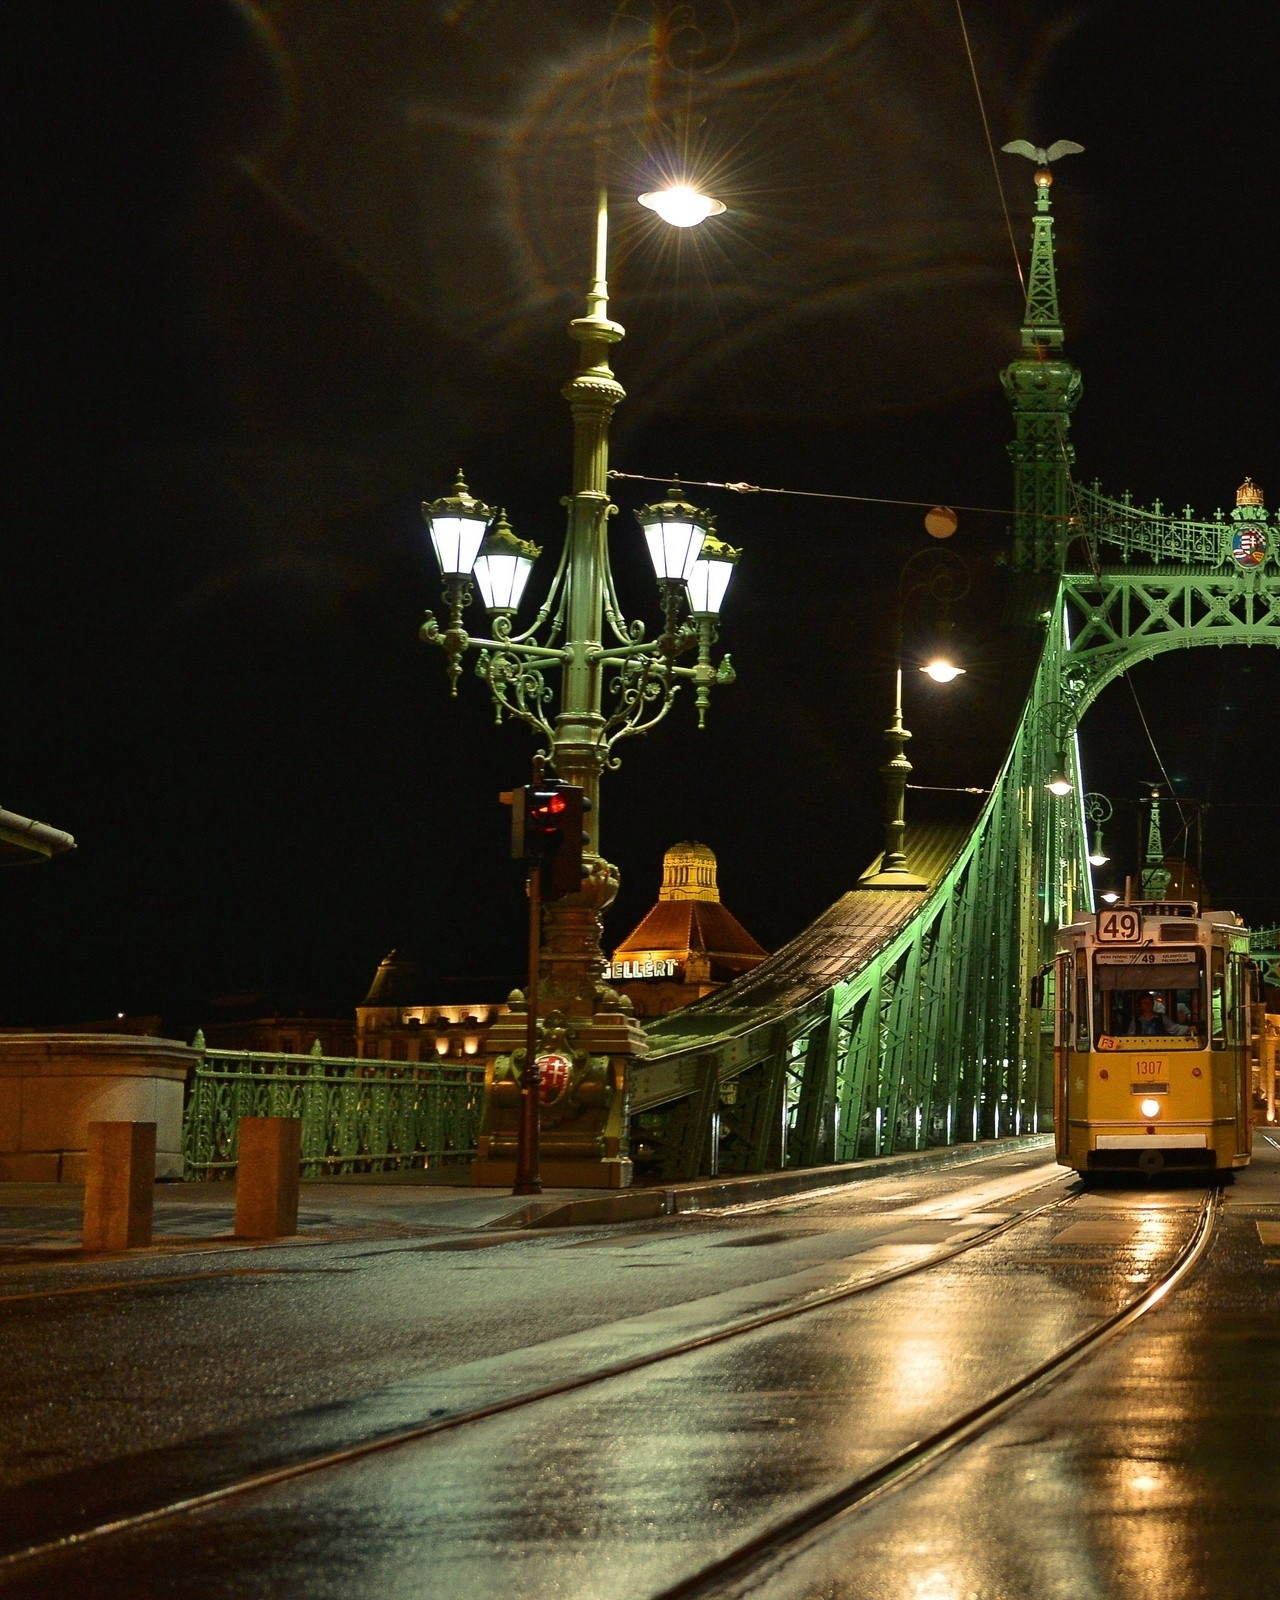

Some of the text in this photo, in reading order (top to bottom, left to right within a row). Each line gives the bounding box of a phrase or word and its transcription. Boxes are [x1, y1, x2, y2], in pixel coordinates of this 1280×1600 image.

[1103, 914, 1136, 939] 49
[1141, 954, 1156, 963] 49
[1101, 1038, 1114, 1049] F3
[1136, 1061, 1163, 1075] 1307
